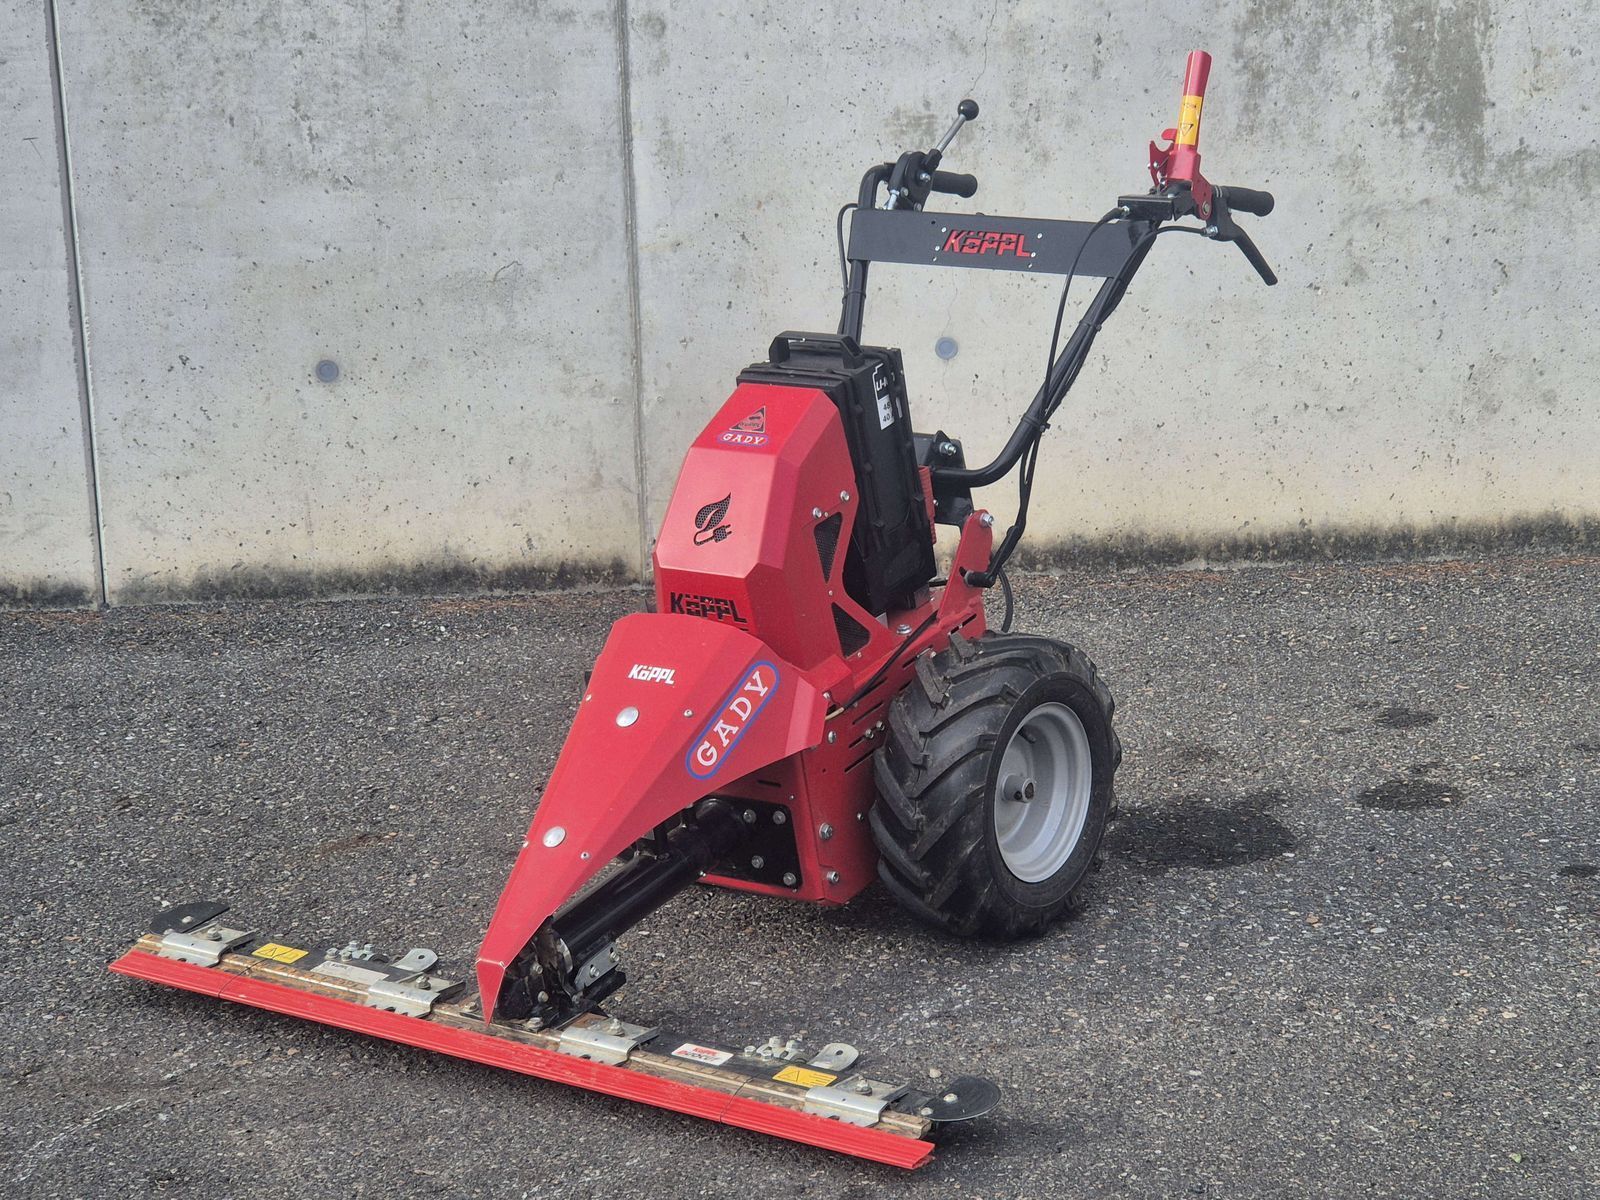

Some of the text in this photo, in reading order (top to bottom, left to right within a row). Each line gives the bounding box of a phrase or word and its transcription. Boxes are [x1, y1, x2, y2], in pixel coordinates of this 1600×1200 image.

[943, 229, 1030, 257] KÖPPL
[722, 433, 764, 445] GADY
[670, 592, 748, 623] KÖPPL
[628, 664, 675, 685] KÖPPL
[697, 671, 768, 766] GADY
